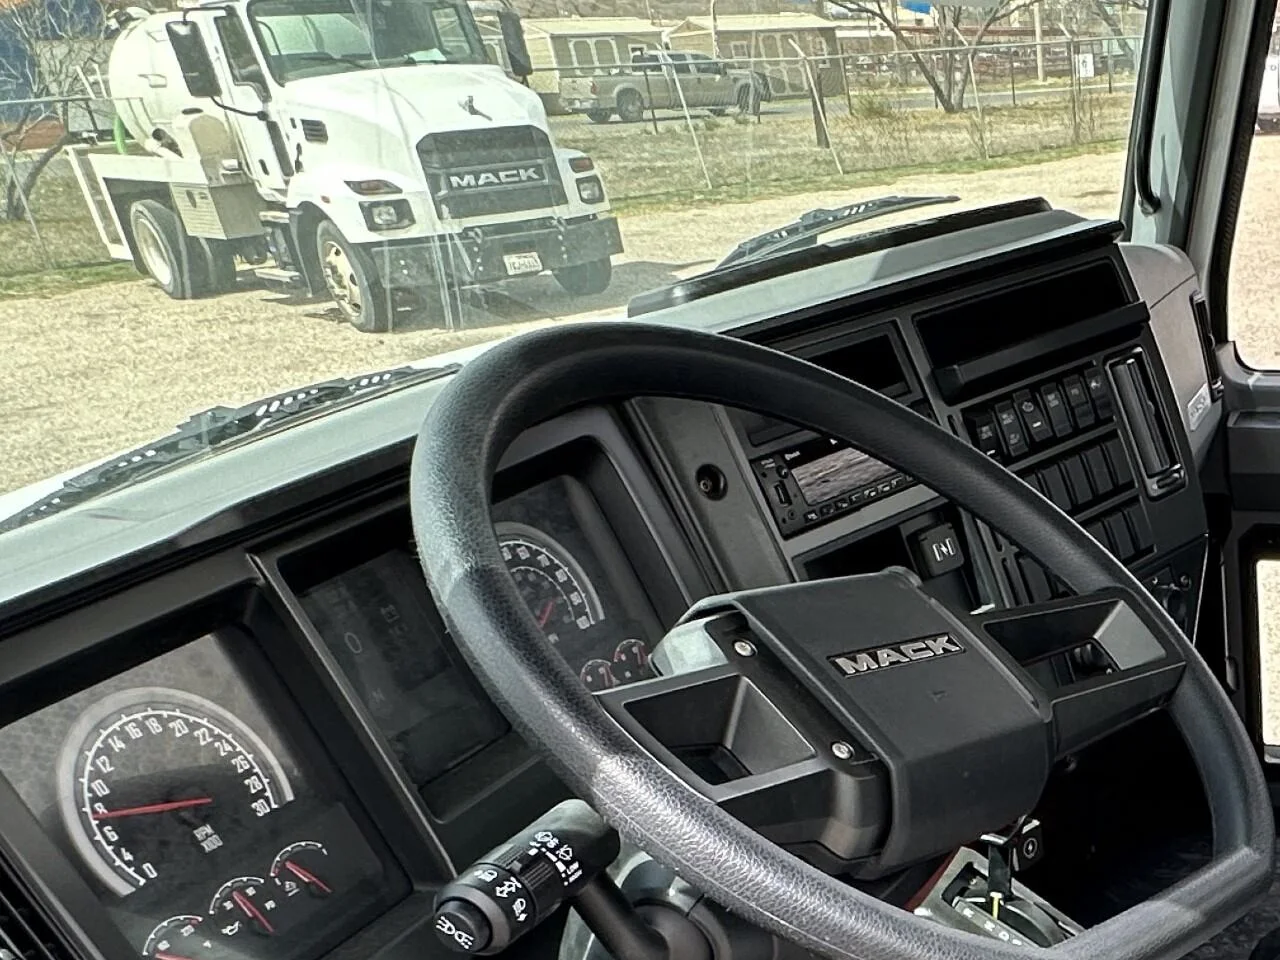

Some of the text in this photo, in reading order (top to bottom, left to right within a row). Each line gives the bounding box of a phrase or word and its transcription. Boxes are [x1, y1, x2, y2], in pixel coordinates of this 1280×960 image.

[449, 167, 540, 188] MACK
[835, 635, 961, 675] MACK
[125, 722, 143, 740] 16
[145, 717, 163, 735] 18
[168, 719, 189, 738] 20
[108, 735, 126, 753] 14
[193, 727, 214, 746] 22
[214, 739, 234, 756] 24
[96, 755, 115, 774] 12
[231, 755, 250, 773] 26
[91, 779, 110, 797] 10
[244, 775, 263, 794] 28
[251, 799, 271, 817] 30
[103, 825, 119, 842] 6
[121, 847, 134, 862] 4
[142, 862, 158, 879] 0
